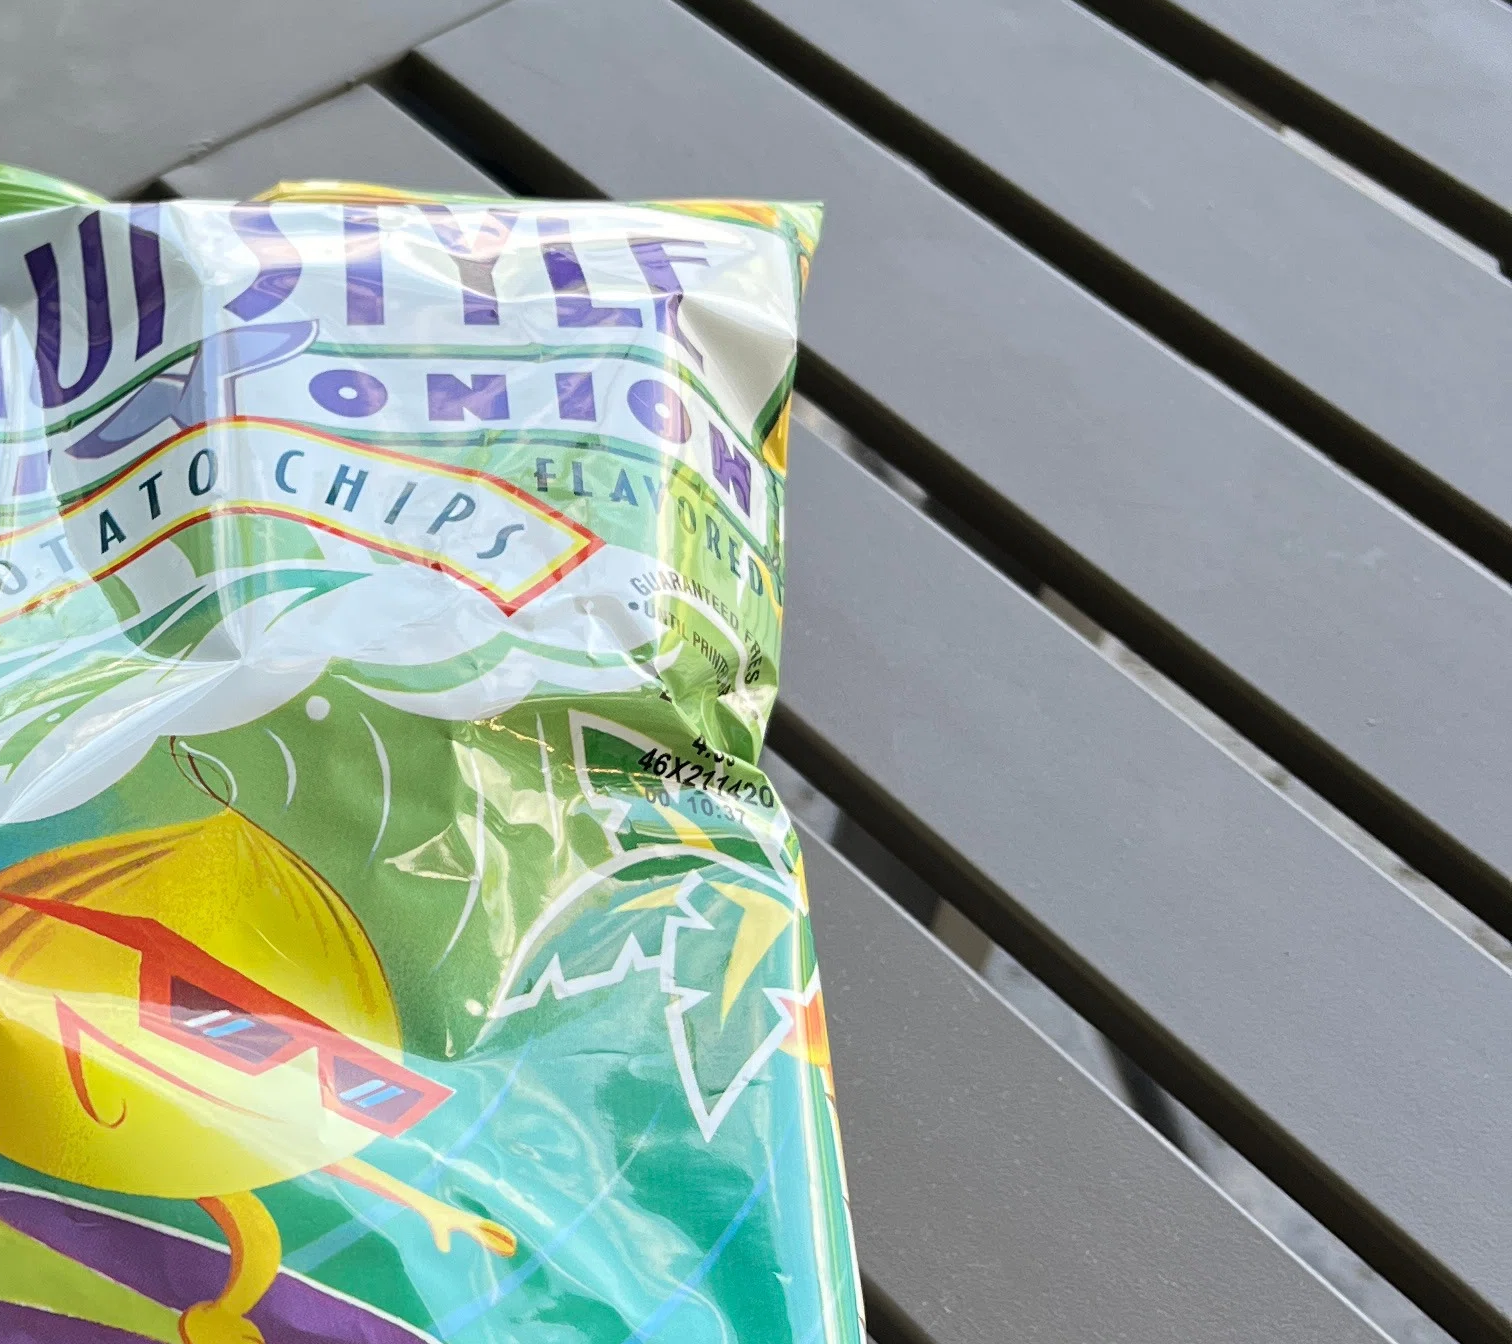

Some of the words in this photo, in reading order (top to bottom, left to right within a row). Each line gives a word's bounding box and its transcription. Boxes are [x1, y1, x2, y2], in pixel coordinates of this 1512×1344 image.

[275, 449, 525, 560] CHIPS
[308, 369, 752, 518] ONION
[534, 457, 765, 597] FLAVORED
[629, 570, 739, 631] GUARANTEED
[745, 628, 763, 685] FRES
